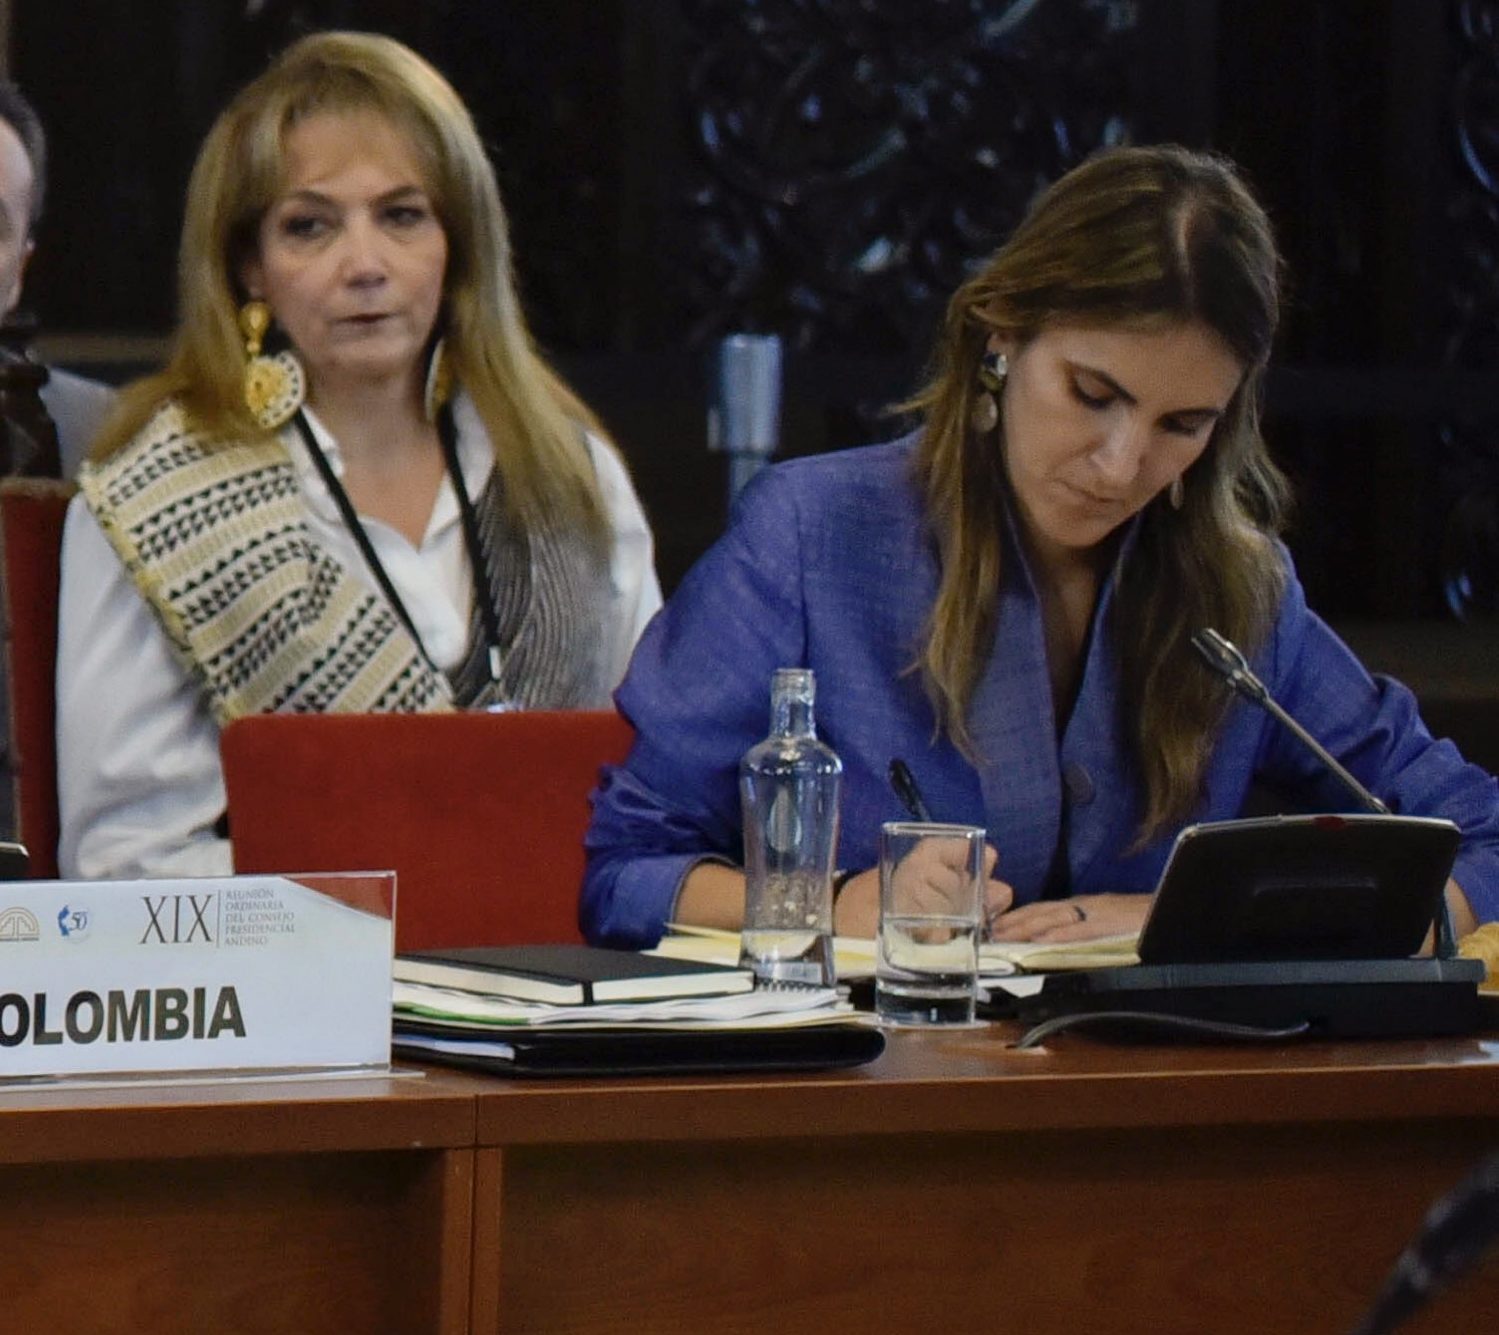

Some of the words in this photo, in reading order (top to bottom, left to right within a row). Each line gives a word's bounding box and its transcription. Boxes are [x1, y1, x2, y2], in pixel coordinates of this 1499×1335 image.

[225, 900, 285, 912] ORDINARIA
[138, 894, 214, 944] XIX
[225, 913, 245, 924] DEL
[248, 911, 295, 923] CONSEJO
[225, 924, 296, 935] PRESIDENCIAL
[224, 936, 268, 947] ANDINO
